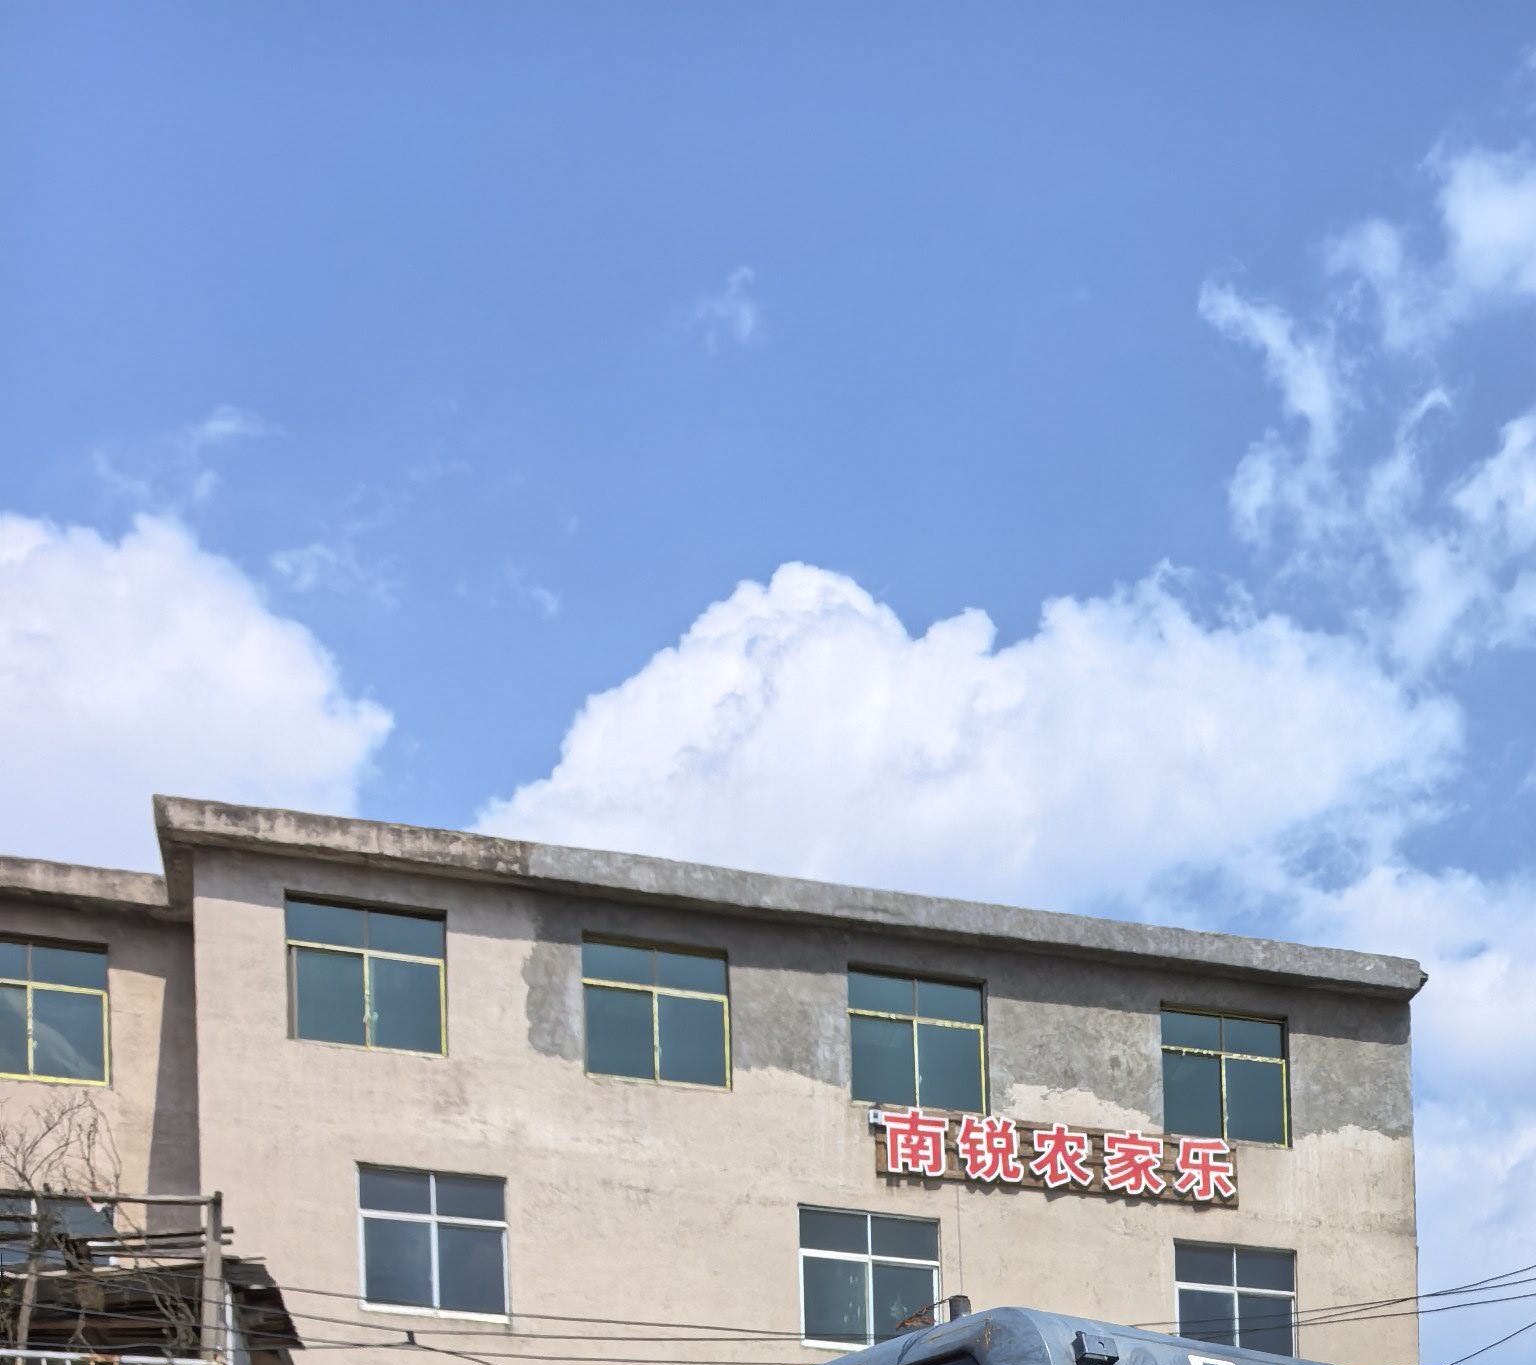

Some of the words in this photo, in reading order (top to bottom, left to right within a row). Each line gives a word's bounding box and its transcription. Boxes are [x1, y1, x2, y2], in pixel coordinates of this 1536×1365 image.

[882, 1107, 1238, 1201] 南锐农家乐
